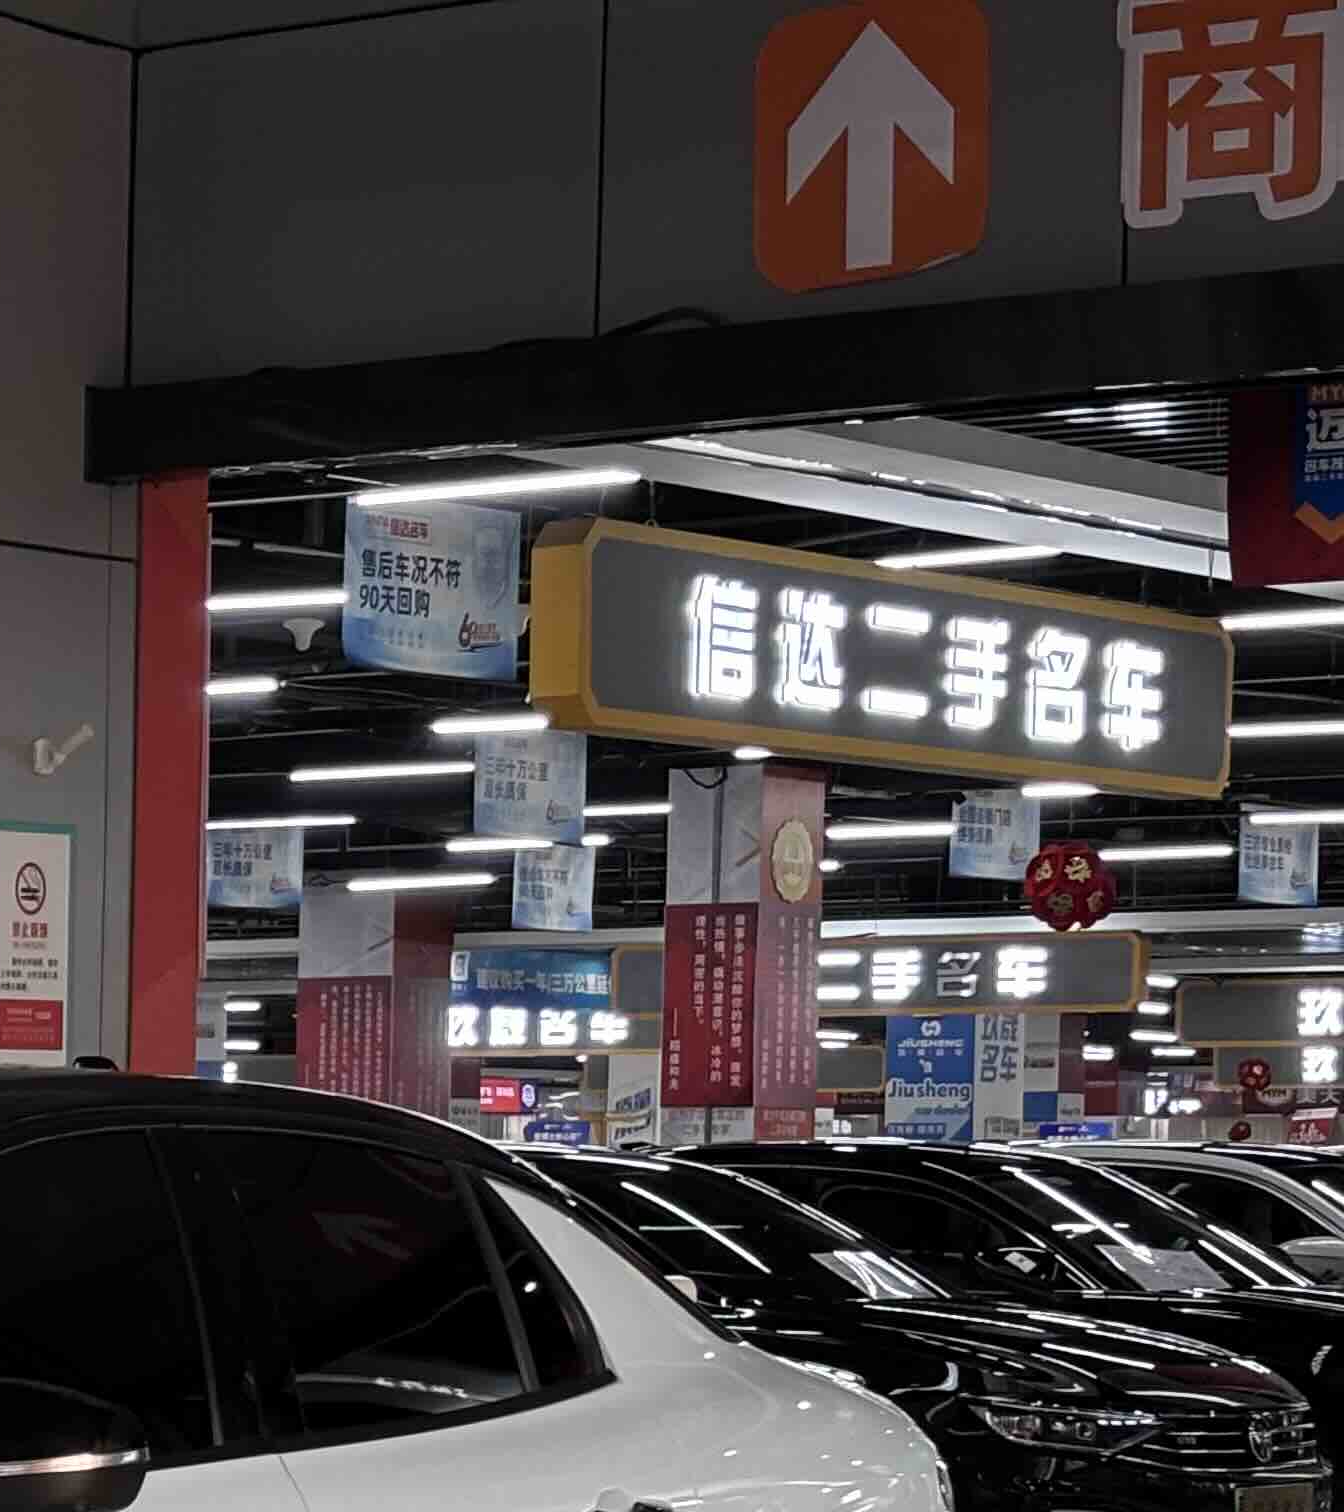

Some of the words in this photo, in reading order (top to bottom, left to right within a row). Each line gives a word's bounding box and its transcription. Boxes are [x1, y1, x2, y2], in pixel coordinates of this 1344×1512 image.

[362, 549, 462, 589] 售后车况不符
[359, 584, 431, 618] 90天回购
[689, 574, 1165, 750] 信达二手名车
[815, 944, 1049, 1001] 二手名车
[888, 1077, 971, 1103] Jiusheng
